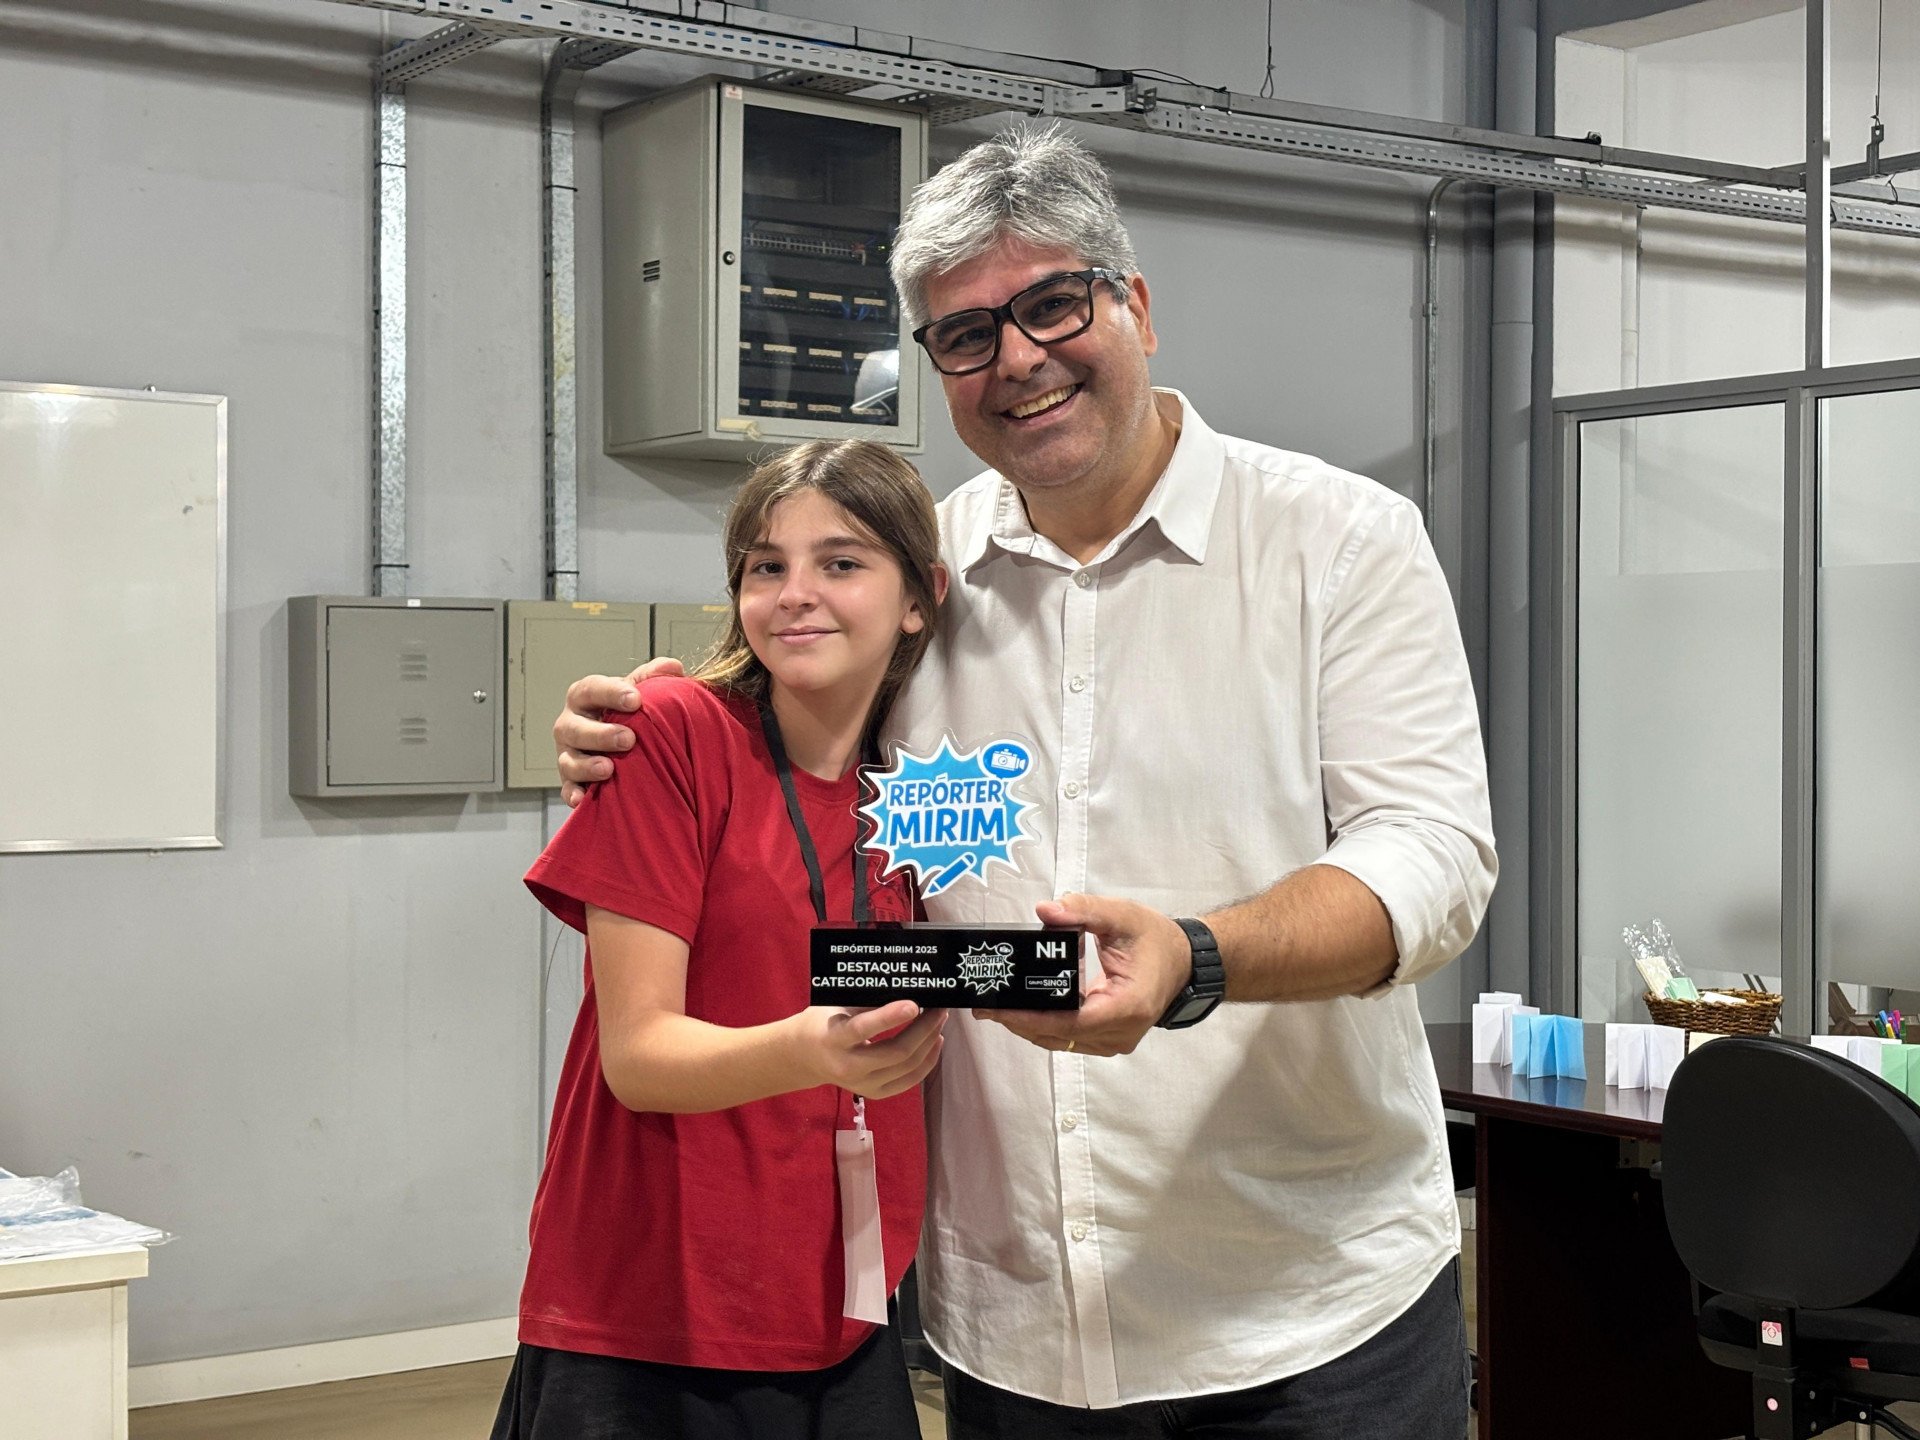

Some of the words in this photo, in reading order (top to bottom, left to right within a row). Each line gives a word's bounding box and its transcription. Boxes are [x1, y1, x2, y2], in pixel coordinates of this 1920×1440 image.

[889, 772, 1002, 806] REPÓRTER
[889, 806, 1006, 846] MIRIM
[830, 944, 881, 954] REPÓRTER
[884, 945, 913, 954] MIRIM
[915, 945, 938, 954] 2025
[1036, 941, 1066, 959] NH
[966, 953, 1005, 965] REPÓRTER
[837, 961, 909, 974] DESTAQUE
[911, 962, 932, 973] NA
[966, 964, 1006, 977] MIRIM
[811, 976, 889, 987] CATEGORIA
[891, 977, 957, 988] DESENHO
